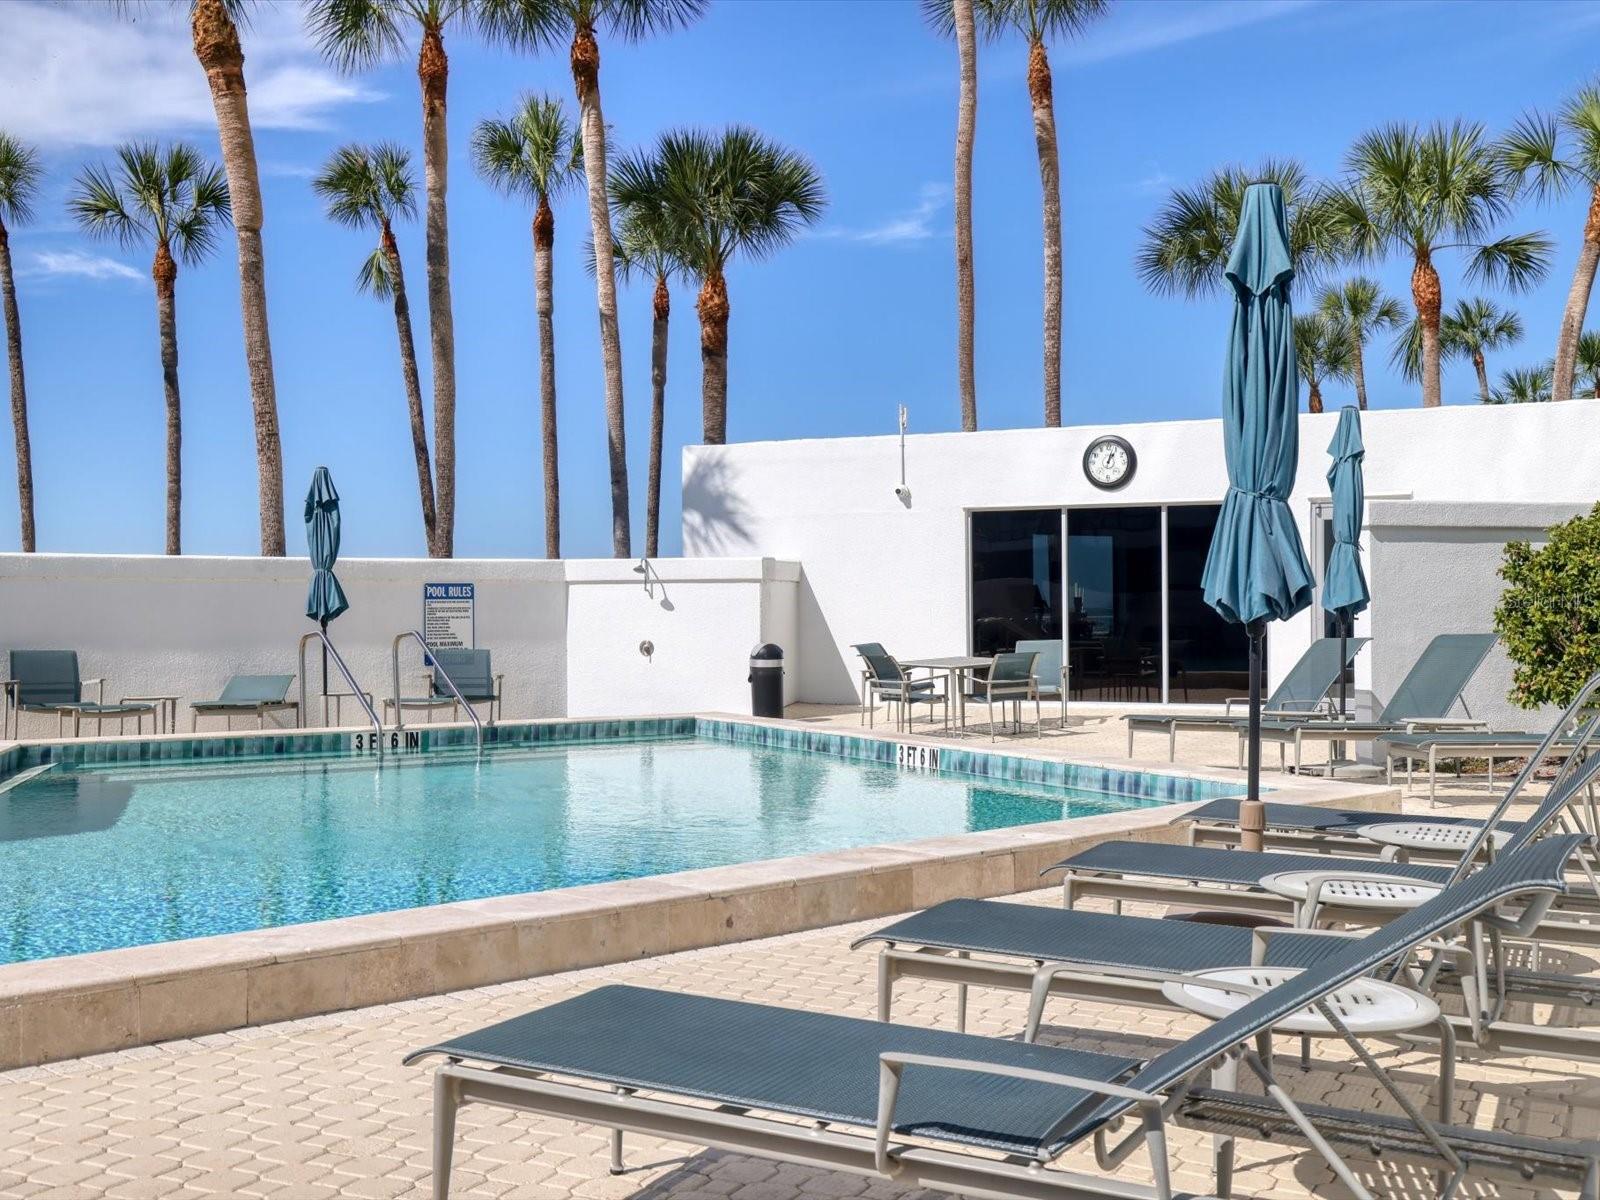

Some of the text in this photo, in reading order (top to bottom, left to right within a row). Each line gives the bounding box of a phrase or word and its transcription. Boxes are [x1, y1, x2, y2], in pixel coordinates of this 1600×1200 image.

[427, 586, 472, 597] POOL RULES
[355, 733, 364, 749] 3
[391, 732, 399, 748] 6
[405, 731, 419, 749] IN
[899, 745, 939, 768] 3 FT 6 IN
